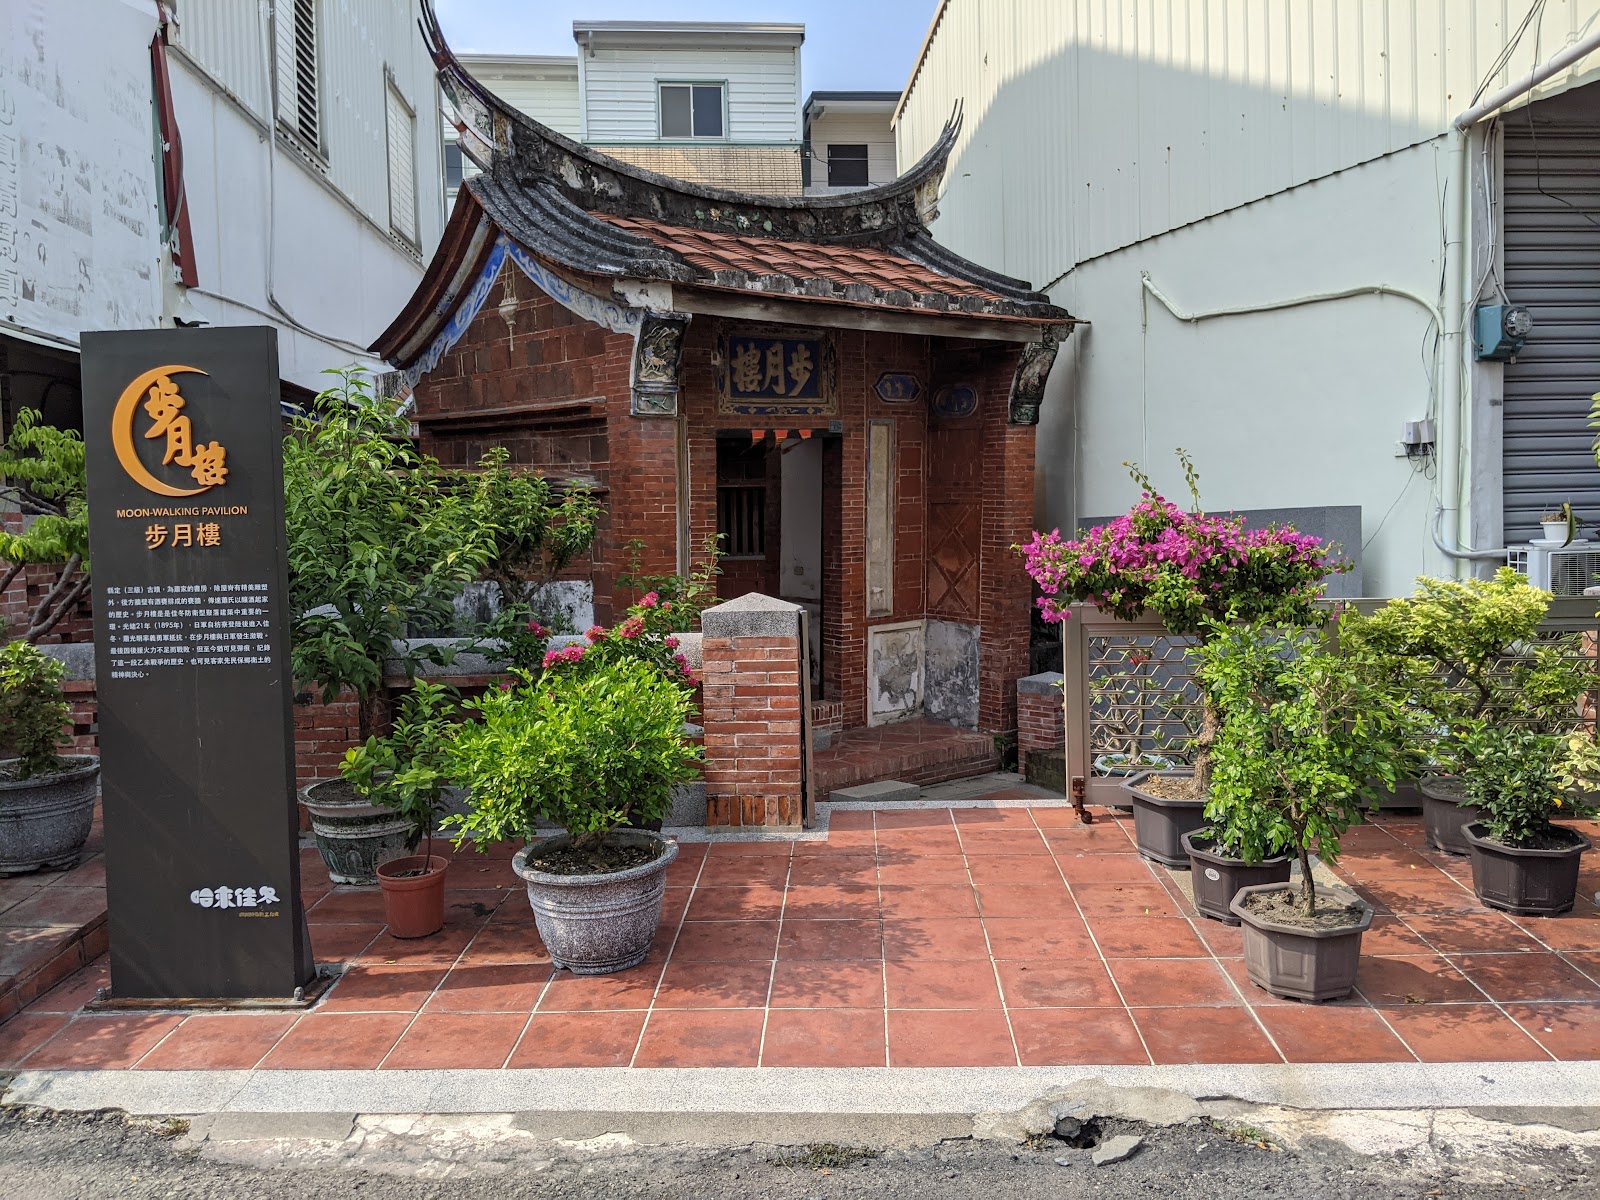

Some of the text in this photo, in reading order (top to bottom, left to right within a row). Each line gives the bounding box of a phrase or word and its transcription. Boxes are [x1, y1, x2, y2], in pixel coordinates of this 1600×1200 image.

[144, 375, 229, 486] 步月樓
[117, 506, 247, 518] MOON-WALKING PAVILION
[145, 522, 221, 550] 步月樓
